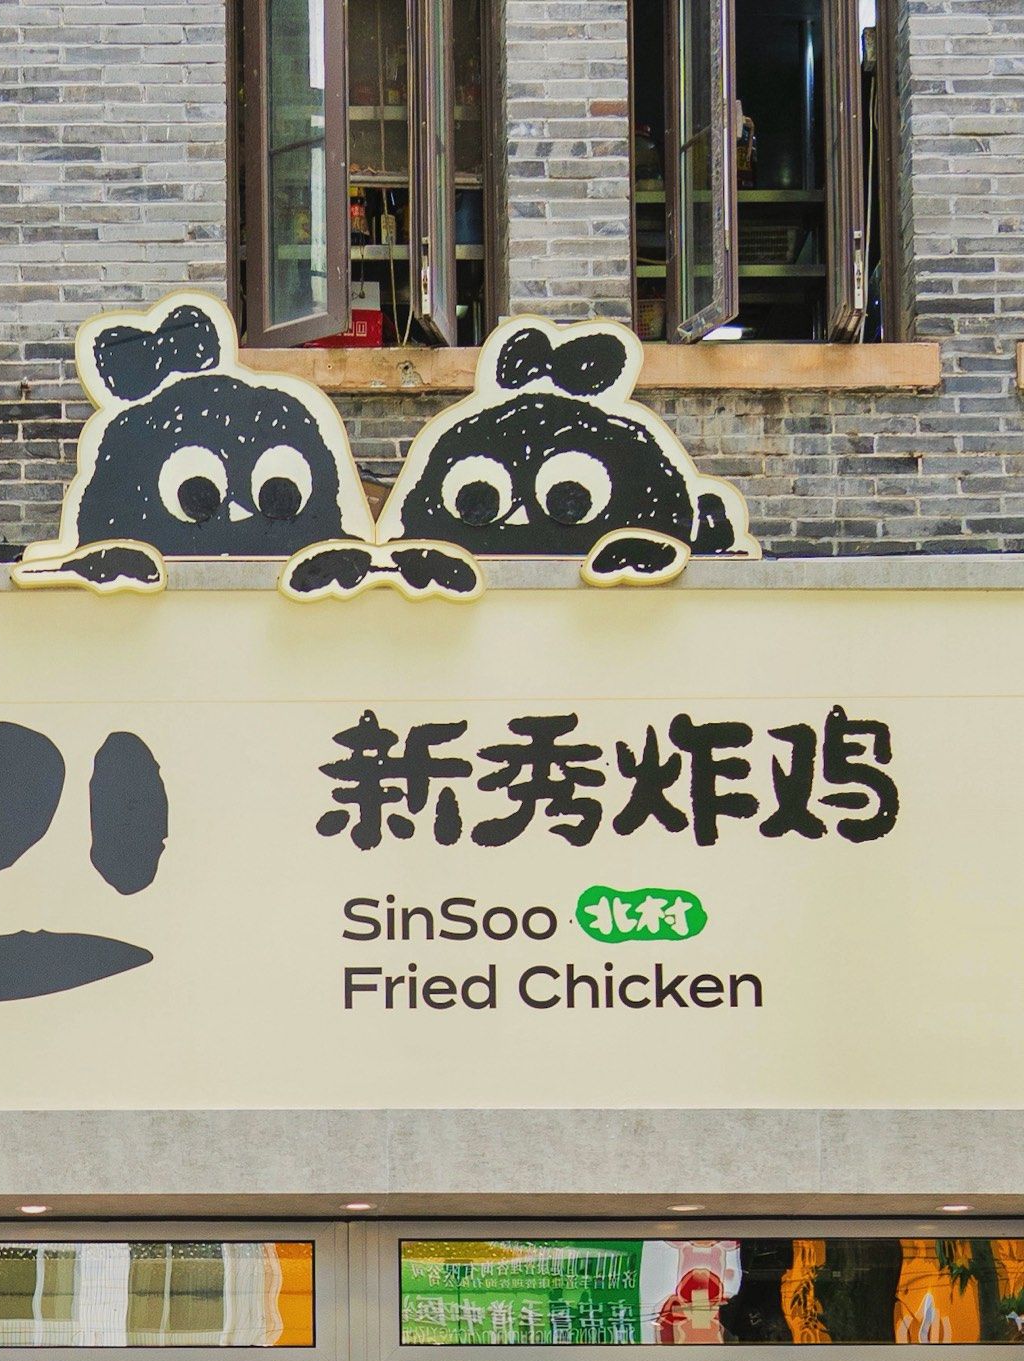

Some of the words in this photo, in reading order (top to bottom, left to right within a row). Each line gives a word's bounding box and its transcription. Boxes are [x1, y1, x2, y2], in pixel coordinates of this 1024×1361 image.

[316, 704, 900, 851] 新秀炸鸡
[341, 894, 558, 942] SinSoo
[583, 895, 694, 936] 北村
[342, 962, 497, 1010] Fried
[518, 962, 764, 1010] Chicken
